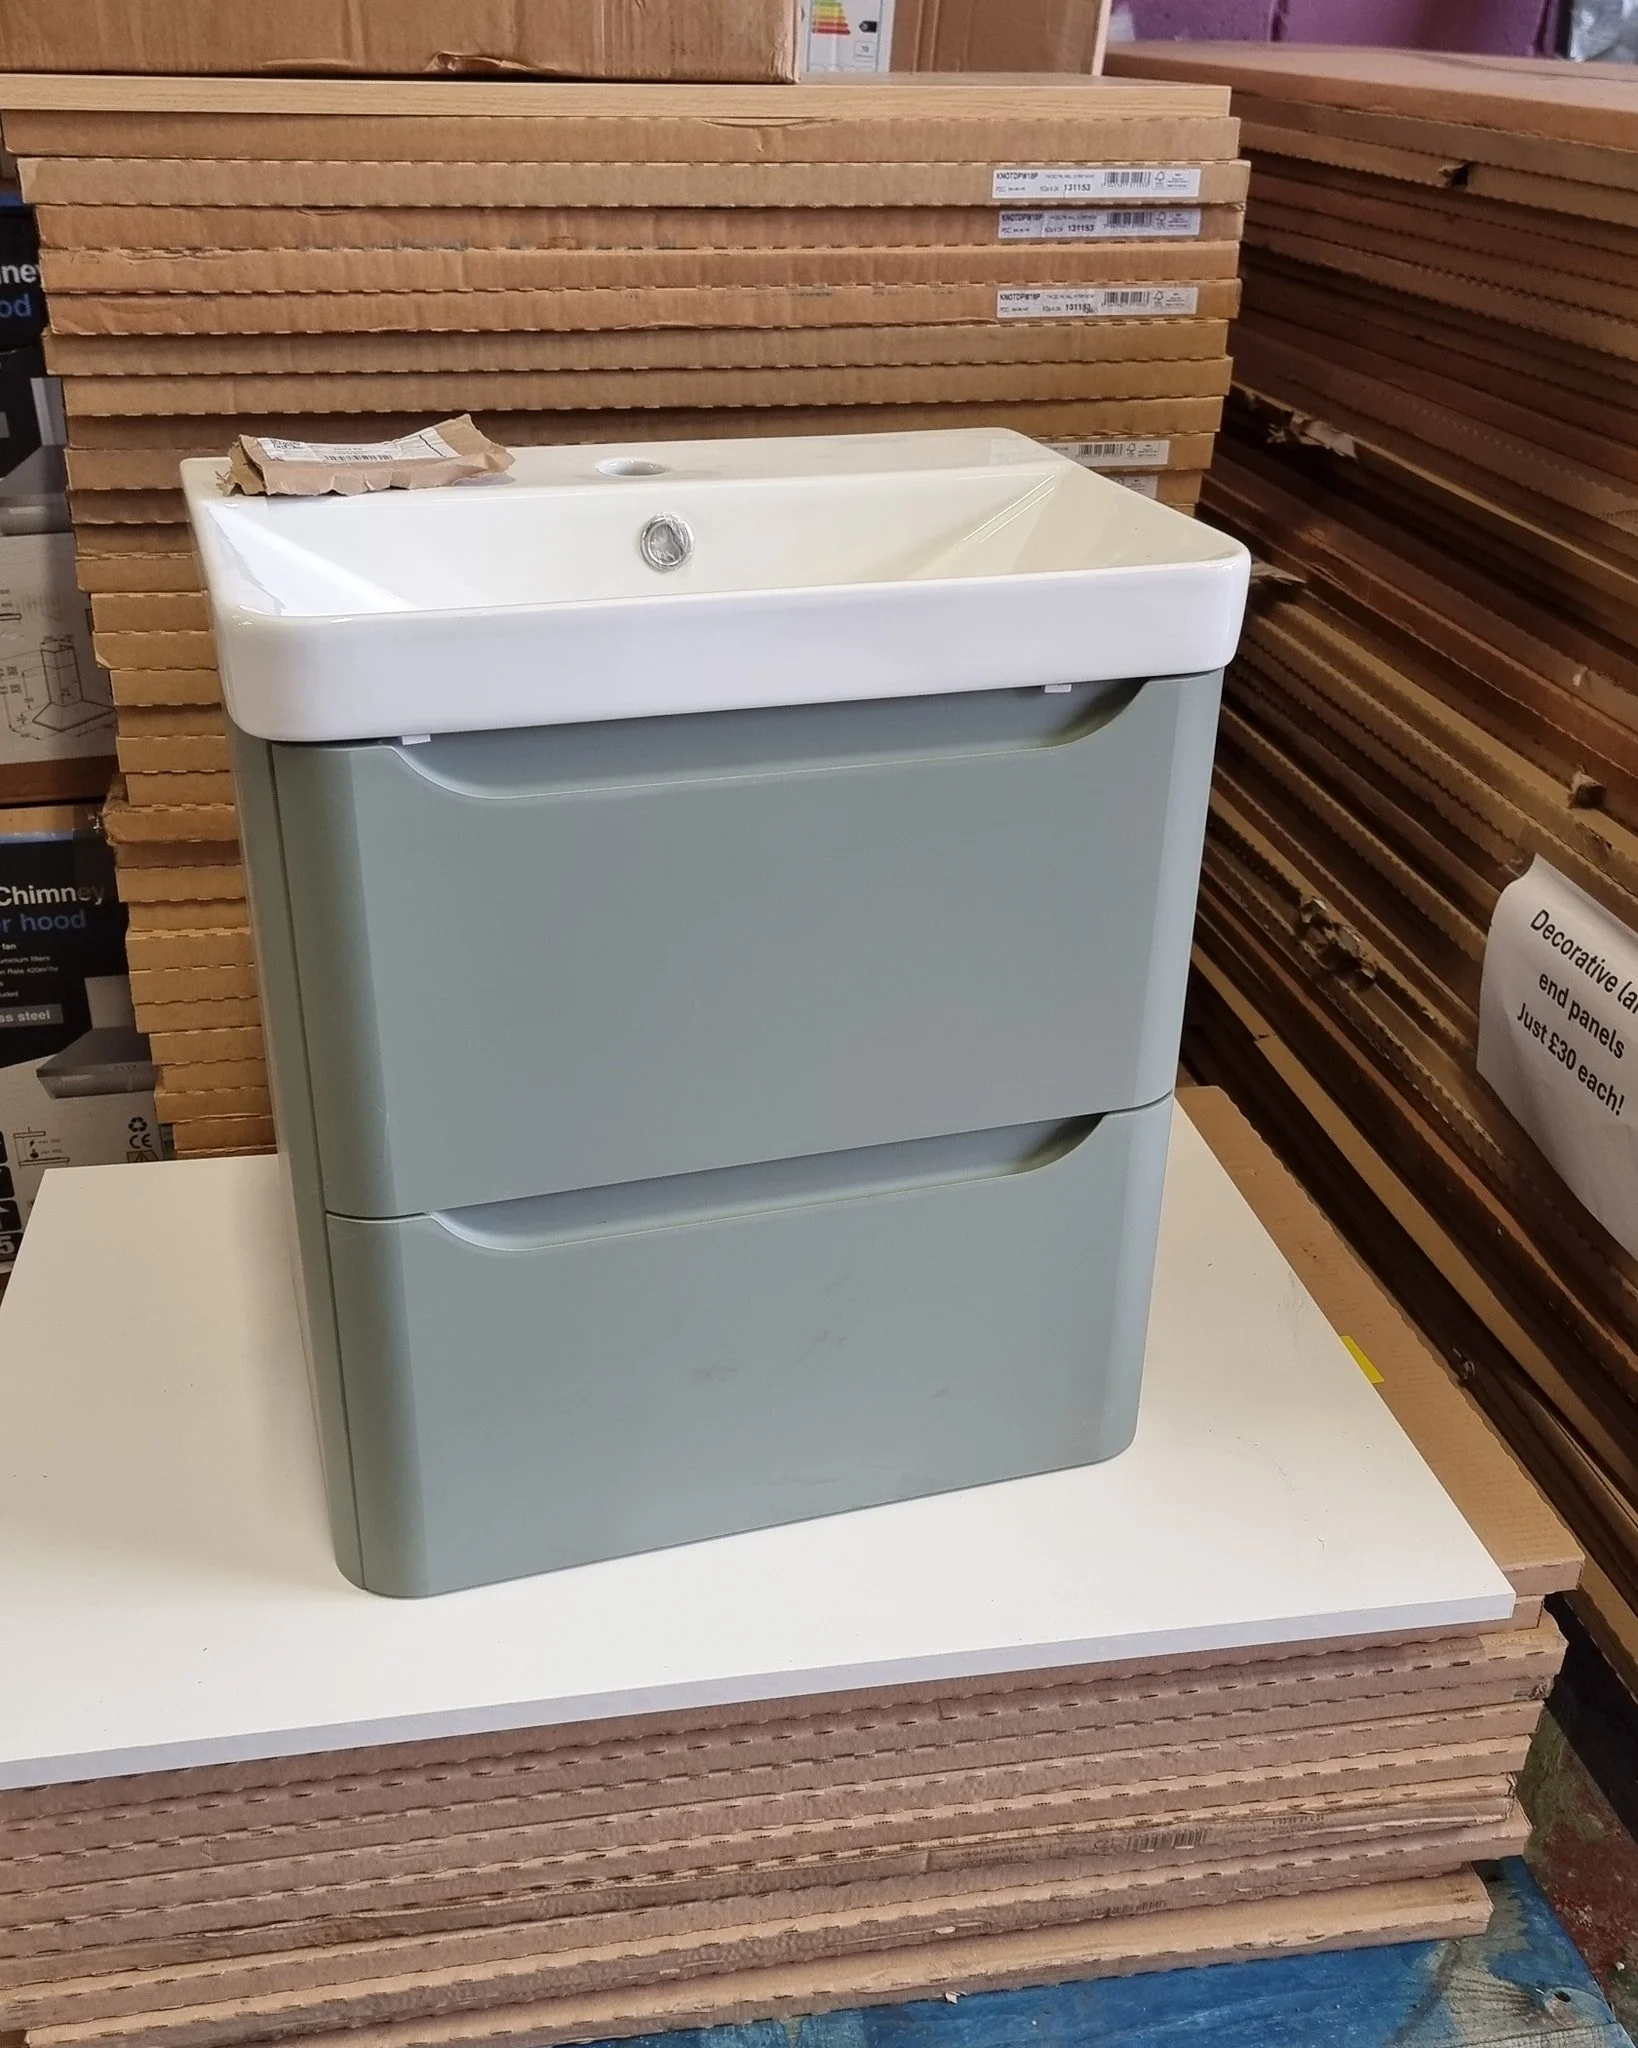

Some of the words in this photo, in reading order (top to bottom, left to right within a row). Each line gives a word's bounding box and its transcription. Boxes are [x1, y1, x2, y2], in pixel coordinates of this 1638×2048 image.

[1064, 183, 1091, 191] 131153
[1068, 224, 1095, 232] 131153
[0, 264, 41, 284] ne
[0, 884, 105, 906] Chimney
[20, 908, 86, 932] hood
[1530, 909, 1618, 992] Decorative
[17, 1009, 51, 1021] steel
[1539, 973, 1569, 1009] end
[1567, 1000, 1625, 1059] panels
[1517, 1003, 1547, 1044] Just
[1547, 1032, 1577, 1071] £30
[1577, 1064, 1625, 1116] each!
